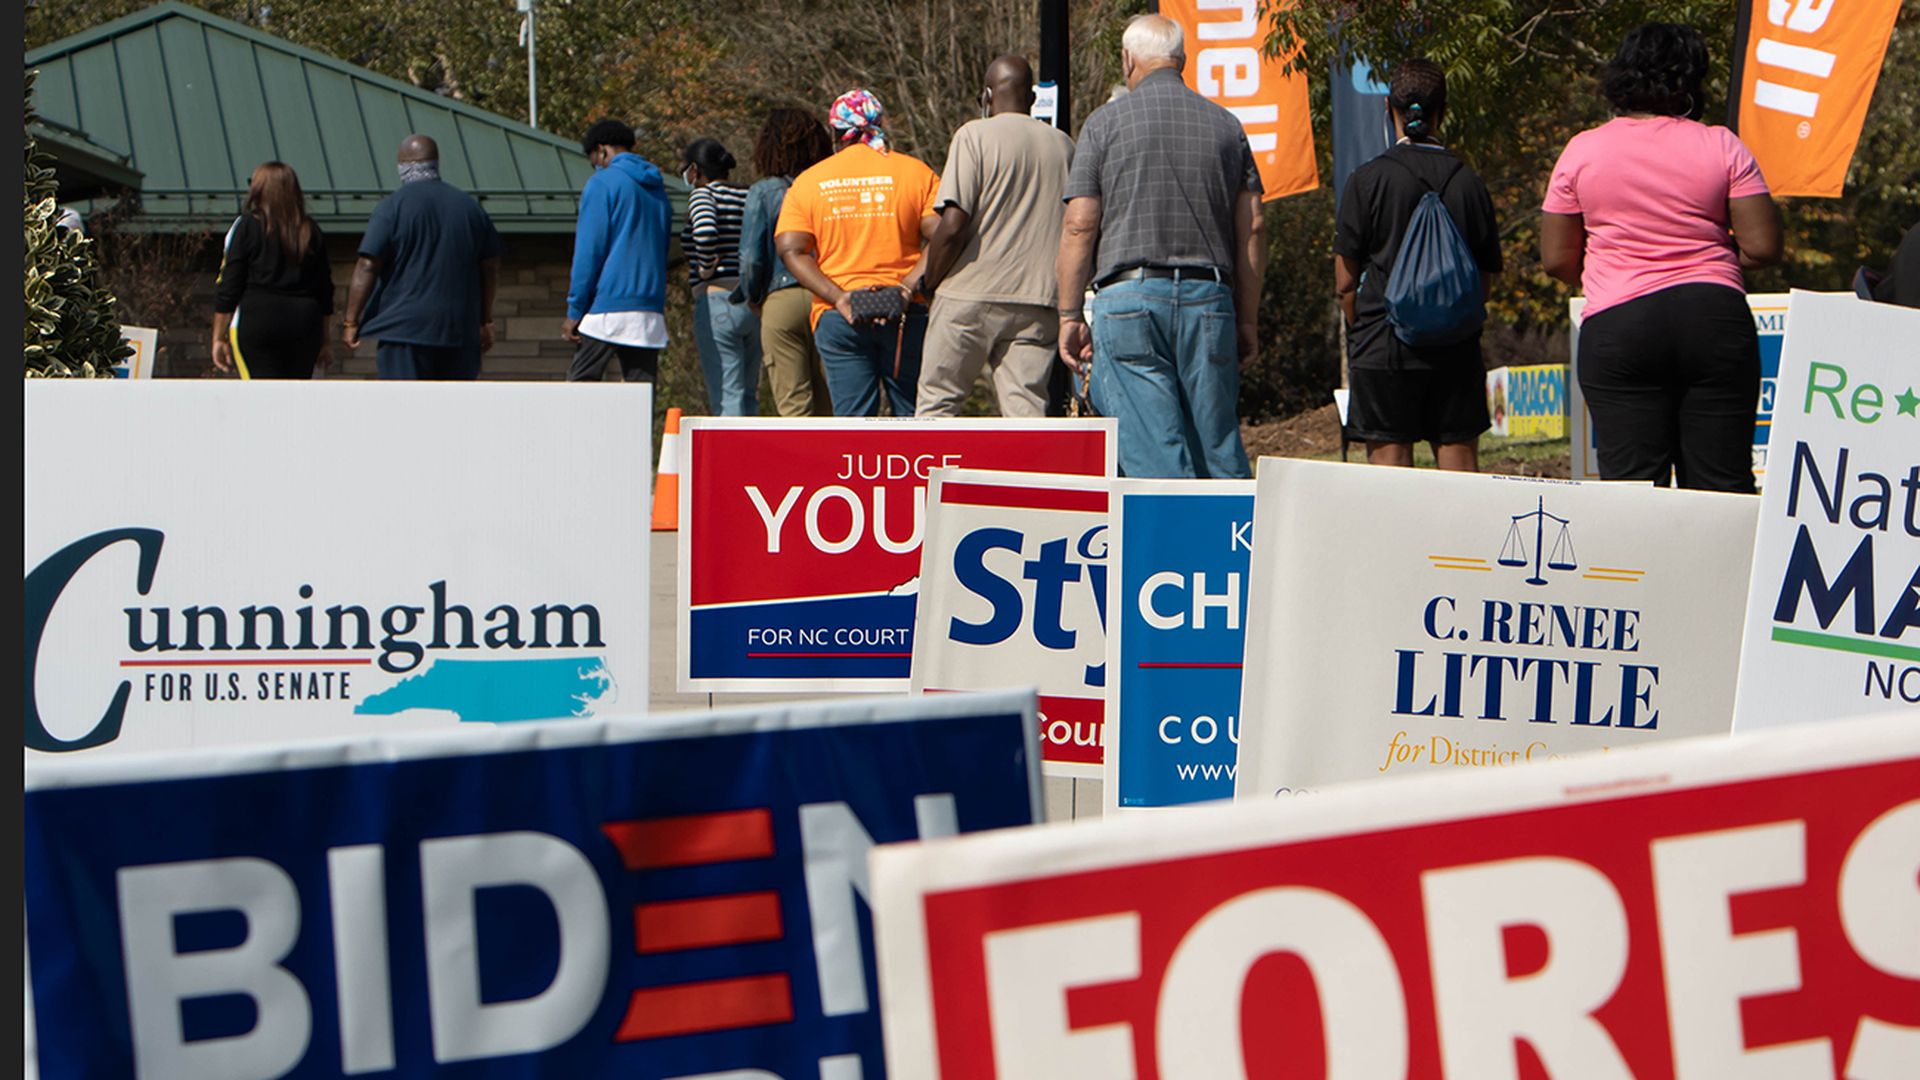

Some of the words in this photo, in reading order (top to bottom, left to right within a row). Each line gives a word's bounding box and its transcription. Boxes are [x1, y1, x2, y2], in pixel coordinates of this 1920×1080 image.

[819, 176, 893, 190] VOLUNTEER
[1787, 441, 1920, 537] Nat
[744, 484, 926, 554] YOU
[1138, 571, 1240, 630] CH
[1423, 595, 1469, 641] C.
[1480, 599, 1640, 652] RENEE
[24, 527, 606, 752] Cunningham
[748, 628, 793, 646] FOR
[799, 628, 828, 646] NC
[834, 628, 909, 646] COURT
[145, 673, 192, 702] FOR
[205, 672, 247, 701] U.S.
[257, 671, 351, 700] SENATE
[1391, 649, 1659, 730] LITTLE
[1379, 731, 1425, 772] for
[1430, 735, 1519, 767] District
[117, 793, 960, 1080] BIDEN
